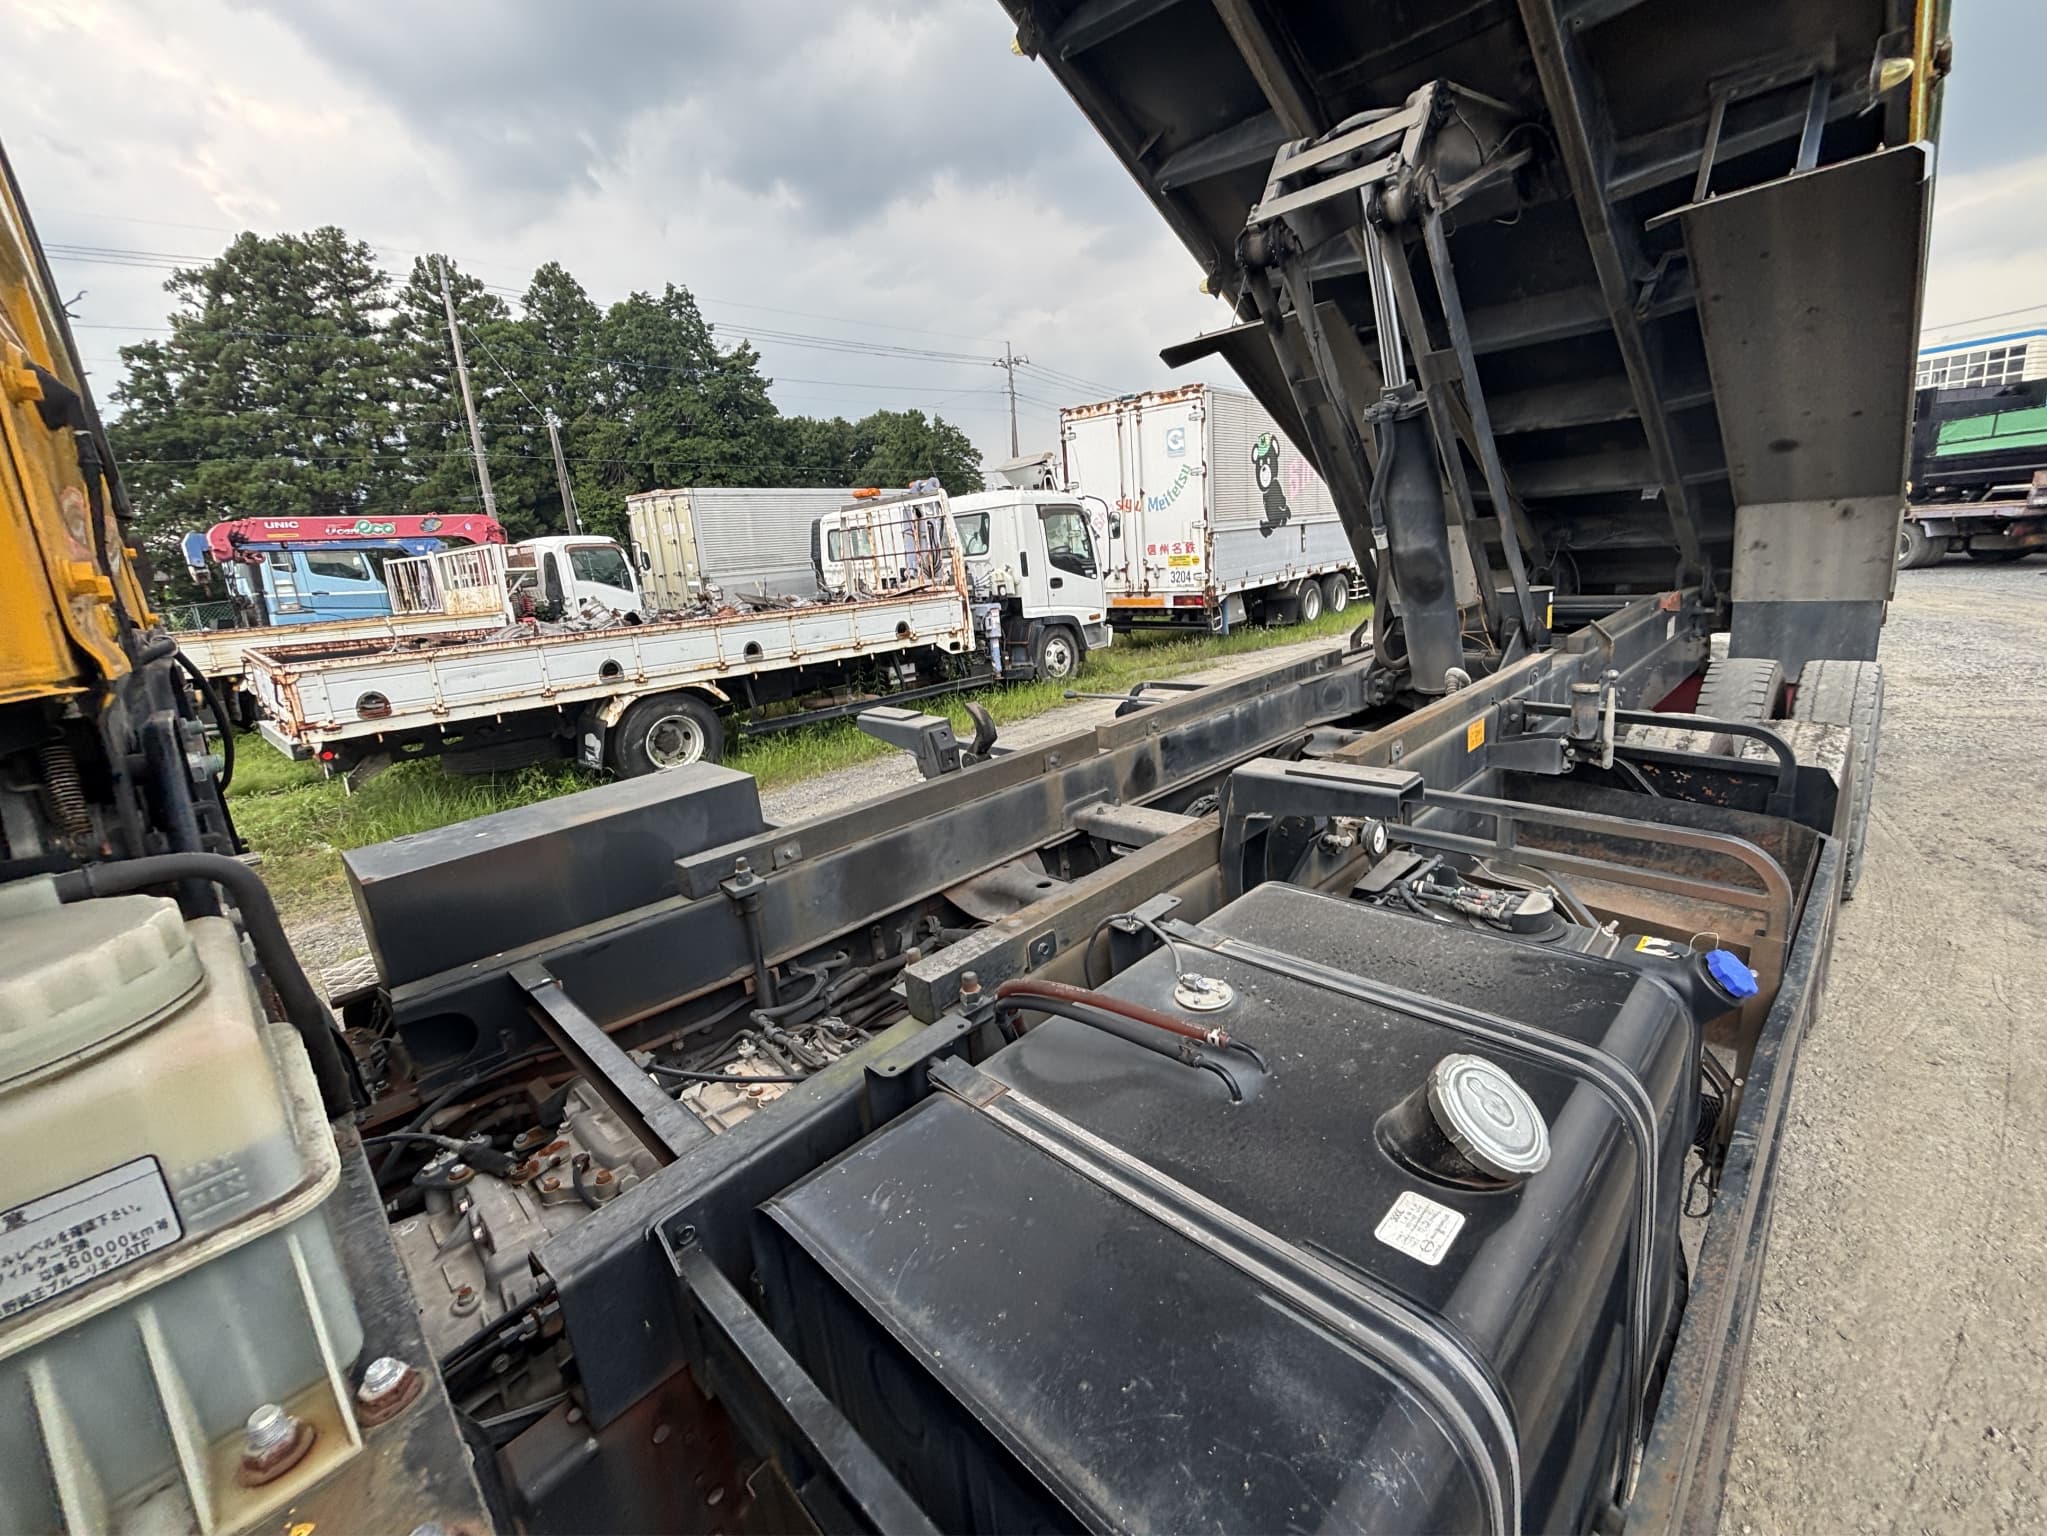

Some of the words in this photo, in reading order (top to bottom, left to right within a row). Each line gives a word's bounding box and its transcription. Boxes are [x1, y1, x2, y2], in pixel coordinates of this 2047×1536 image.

[264, 521, 300, 529] UNIC
[1170, 570, 1191, 583] 3204
[0, 1239, 152, 1317] 野純正ブルーリボンATF
